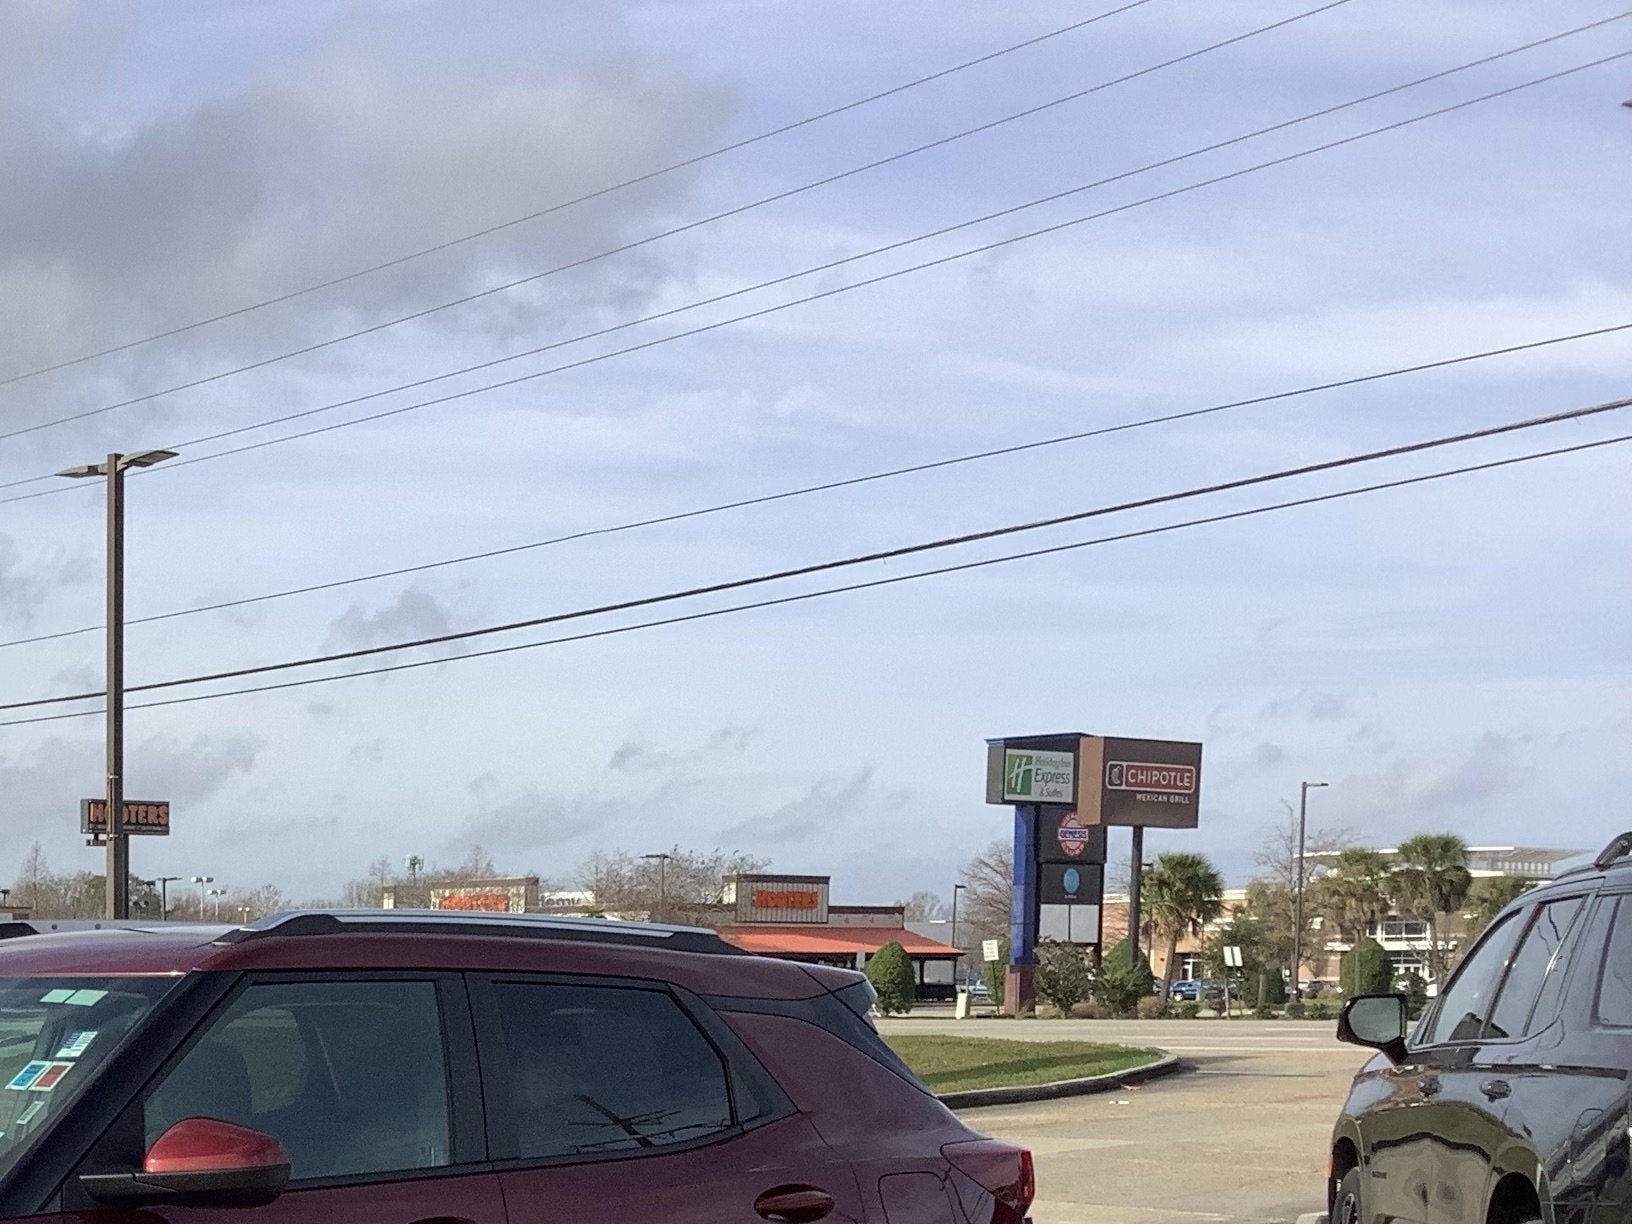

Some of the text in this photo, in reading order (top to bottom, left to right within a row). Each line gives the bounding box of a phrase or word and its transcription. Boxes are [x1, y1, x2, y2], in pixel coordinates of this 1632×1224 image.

[1034, 767, 1071, 787] Express
[1128, 769, 1191, 787] CHIPOTLE
[1045, 787, 1064, 798] Suites
[1136, 794, 1190, 804] MEXICAN GRILL
[1059, 829, 1087, 839] GENESIS
